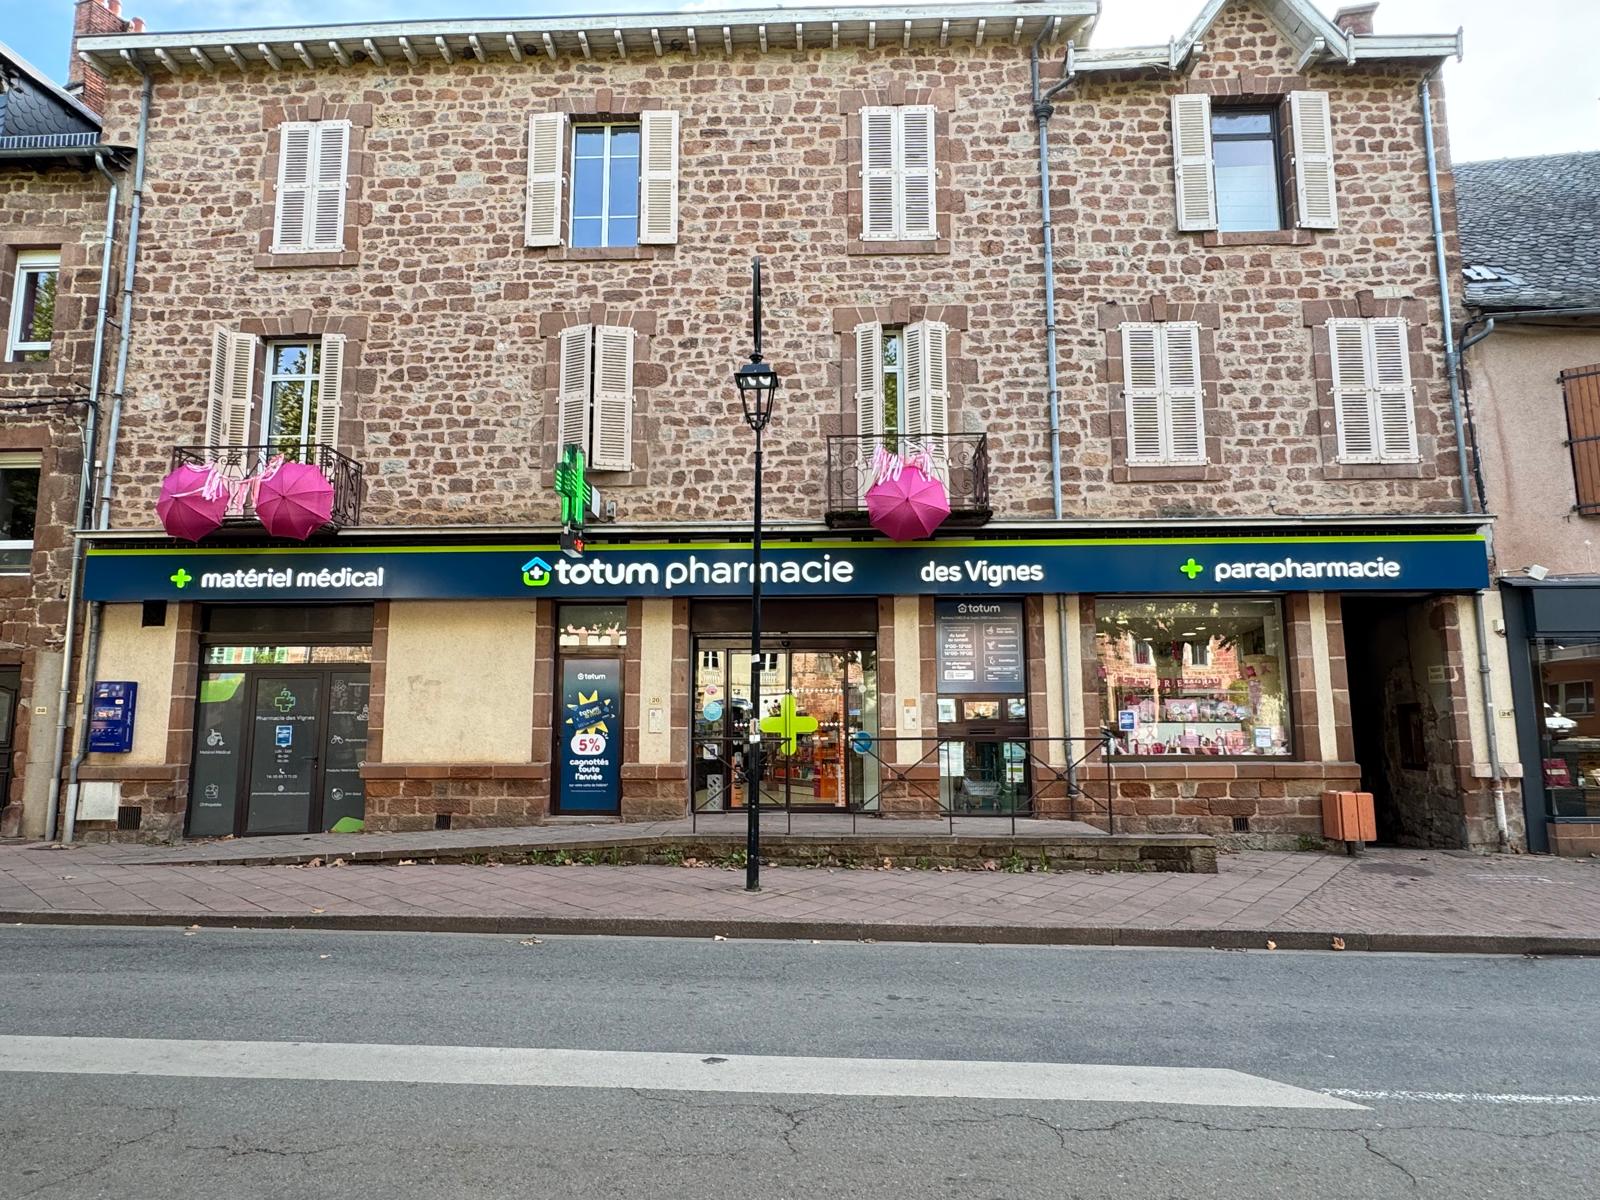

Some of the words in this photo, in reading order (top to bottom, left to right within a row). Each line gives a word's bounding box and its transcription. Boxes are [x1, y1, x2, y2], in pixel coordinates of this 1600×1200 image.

[201, 567, 293, 588] matériel
[296, 567, 384, 588] médical
[554, 558, 659, 585] totum
[665, 554, 854, 589] pharmacie
[920, 560, 962, 582] des
[964, 560, 1044, 587] Vignes
[1214, 557, 1401, 583] parapharmacie
[968, 604, 1001, 613] totum
[578, 737, 601, 752] 5%
